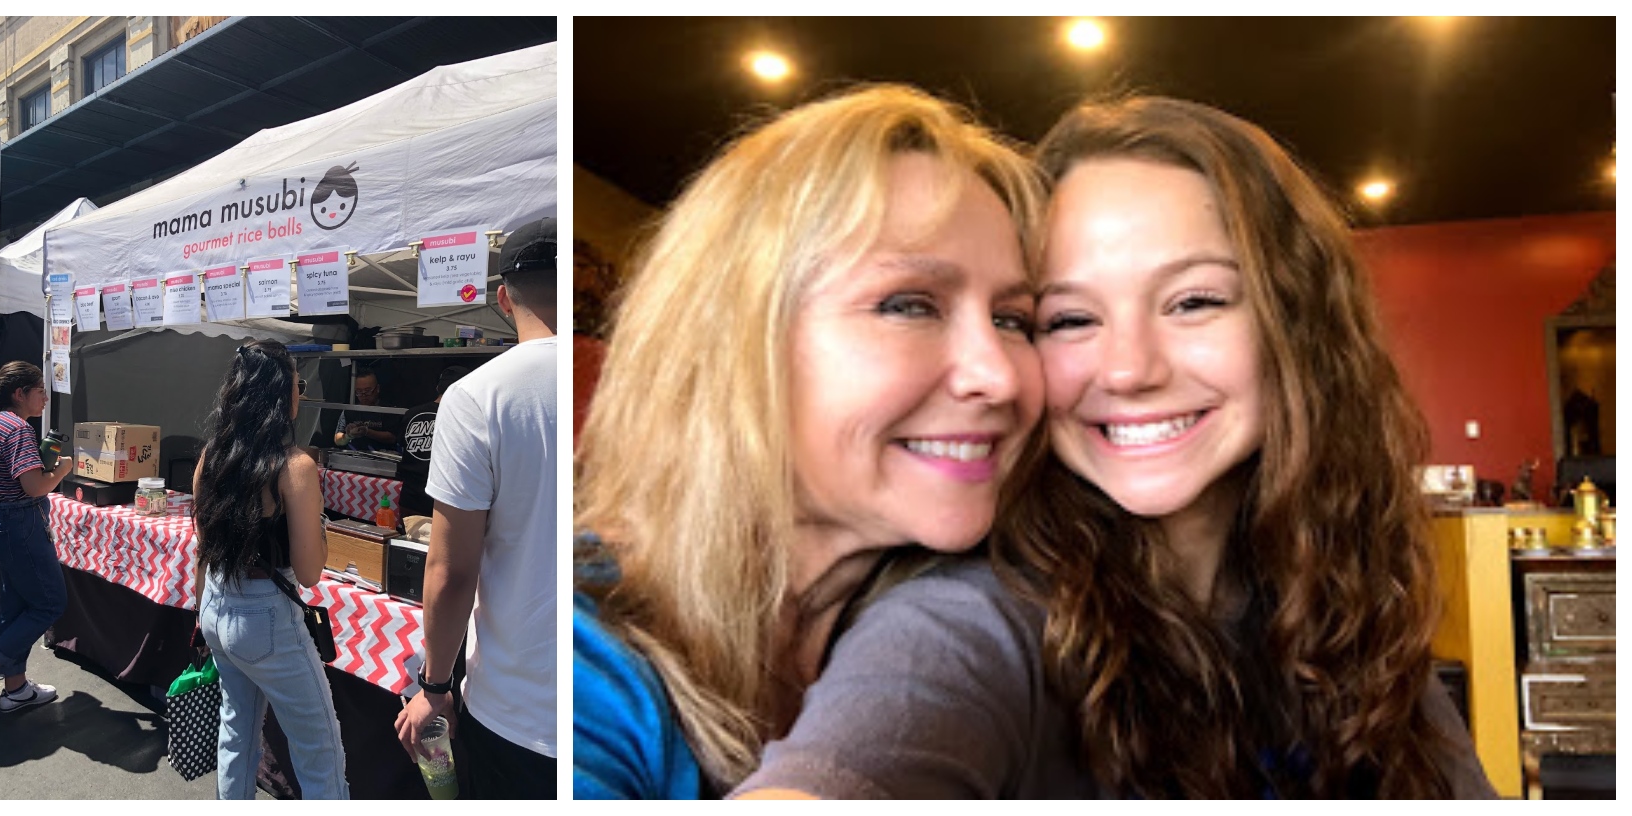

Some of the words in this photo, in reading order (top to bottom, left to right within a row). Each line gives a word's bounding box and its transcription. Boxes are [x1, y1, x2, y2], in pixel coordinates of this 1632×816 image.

[153, 209, 212, 239] mama
[221, 177, 306, 223] musubi
[183, 231, 233, 259] gourmet
[237, 227, 263, 245] rice
[268, 216, 303, 240] balls
[429, 237, 456, 247] musubi
[304, 255, 324, 264] musubi
[429, 255, 447, 264] kelp
[448, 254, 455, 262] &
[456, 253, 476, 262] rayu
[306, 270, 322, 280] spicy
[323, 269, 338, 277] tuna
